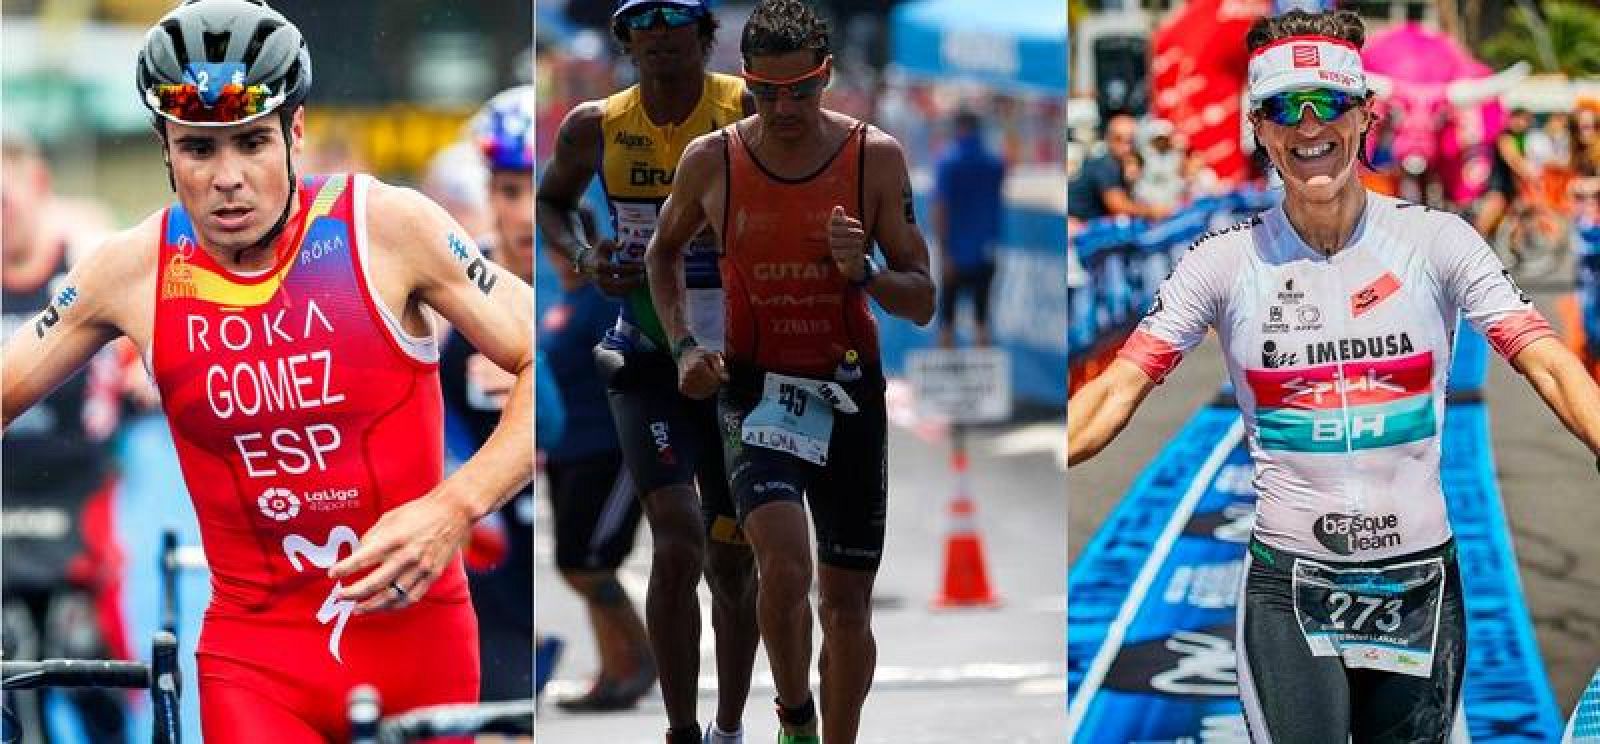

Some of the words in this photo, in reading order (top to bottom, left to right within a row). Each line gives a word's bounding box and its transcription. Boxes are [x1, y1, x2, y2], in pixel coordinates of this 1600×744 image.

[197, 71, 209, 92] 2
[466, 257, 498, 296] 2
[36, 303, 59, 339] 2
[1306, 331, 1414, 365] IMEDUSA
[207, 349, 346, 419] GOMEZ
[1312, 415, 1385, 441] BH
[233, 423, 342, 478] ESP
[1321, 512, 1399, 535] basque
[1347, 532, 1401, 556] team
[1321, 591, 1403, 632] 273
